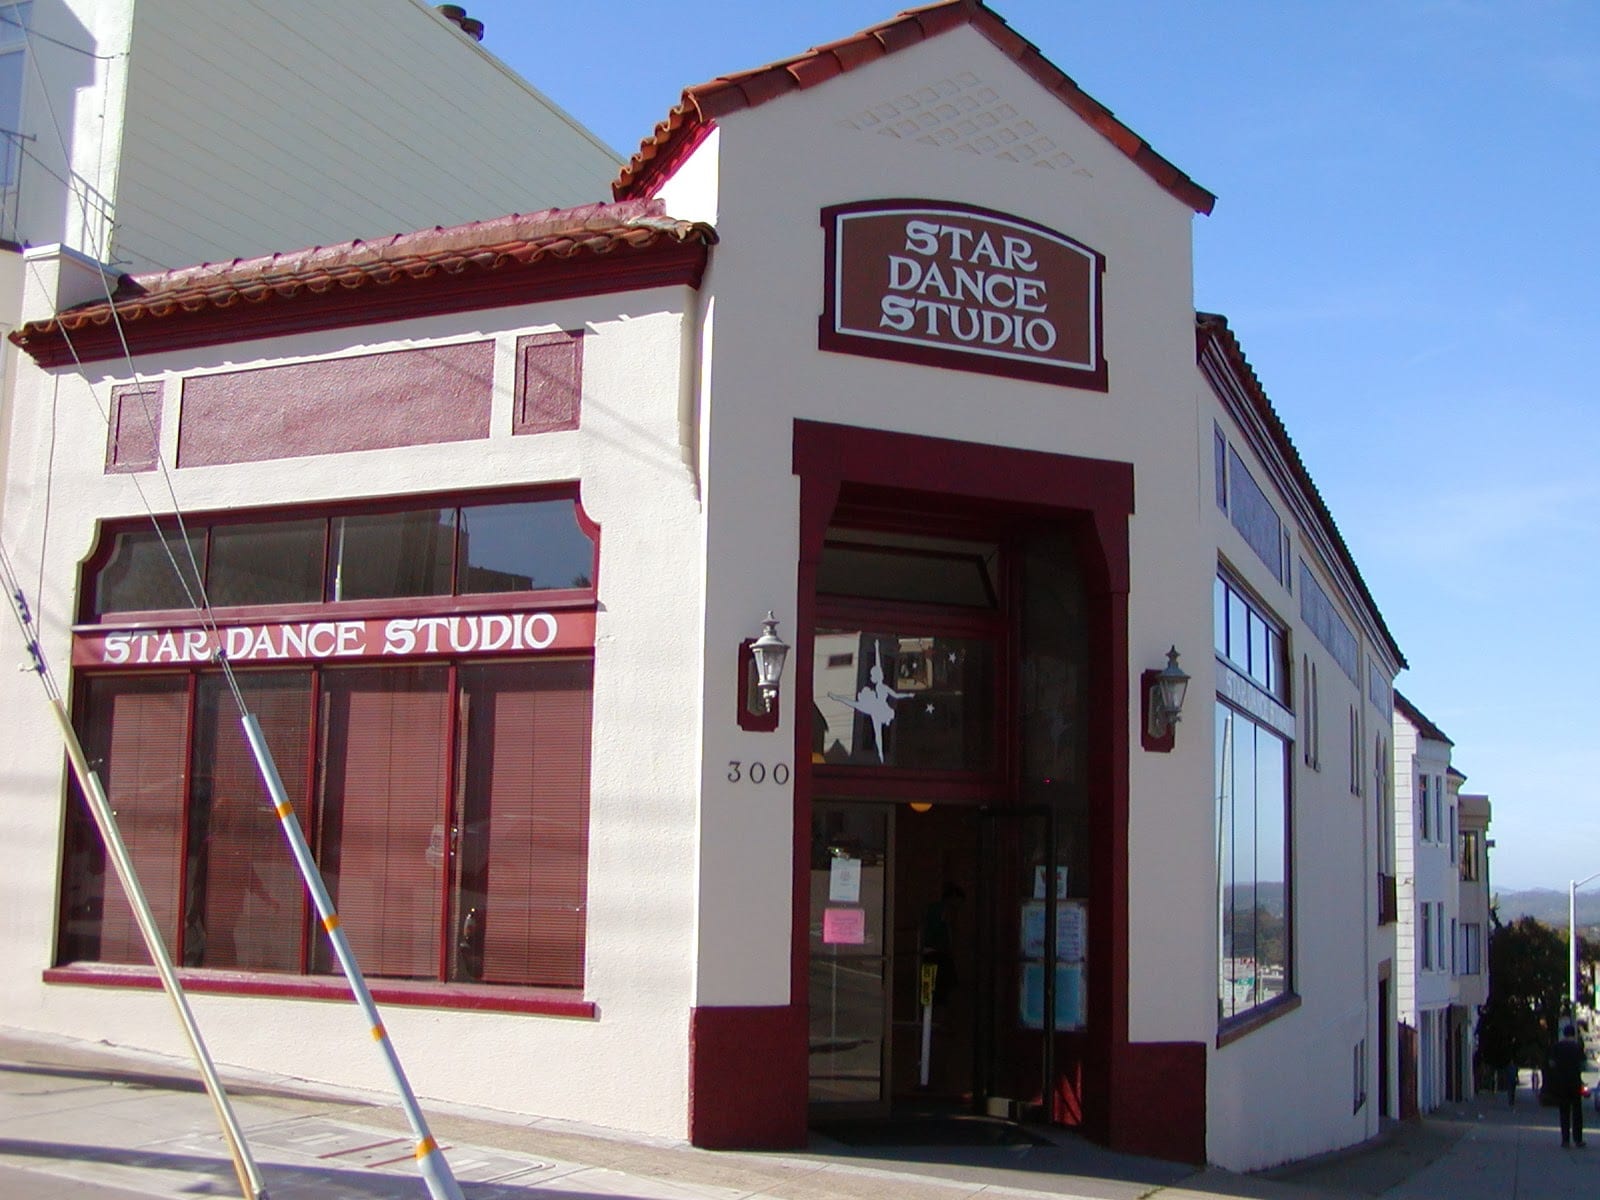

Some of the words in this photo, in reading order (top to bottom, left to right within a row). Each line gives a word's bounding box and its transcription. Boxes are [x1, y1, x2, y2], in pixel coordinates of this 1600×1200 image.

[905, 220, 1037, 272] STAR
[888, 255, 1047, 313] DANCE
[879, 295, 1057, 351] STUDIO
[103, 629, 211, 664] STAR
[227, 621, 367, 660] DANCE
[382, 612, 558, 655] STUDIO
[727, 761, 789, 785] 300
